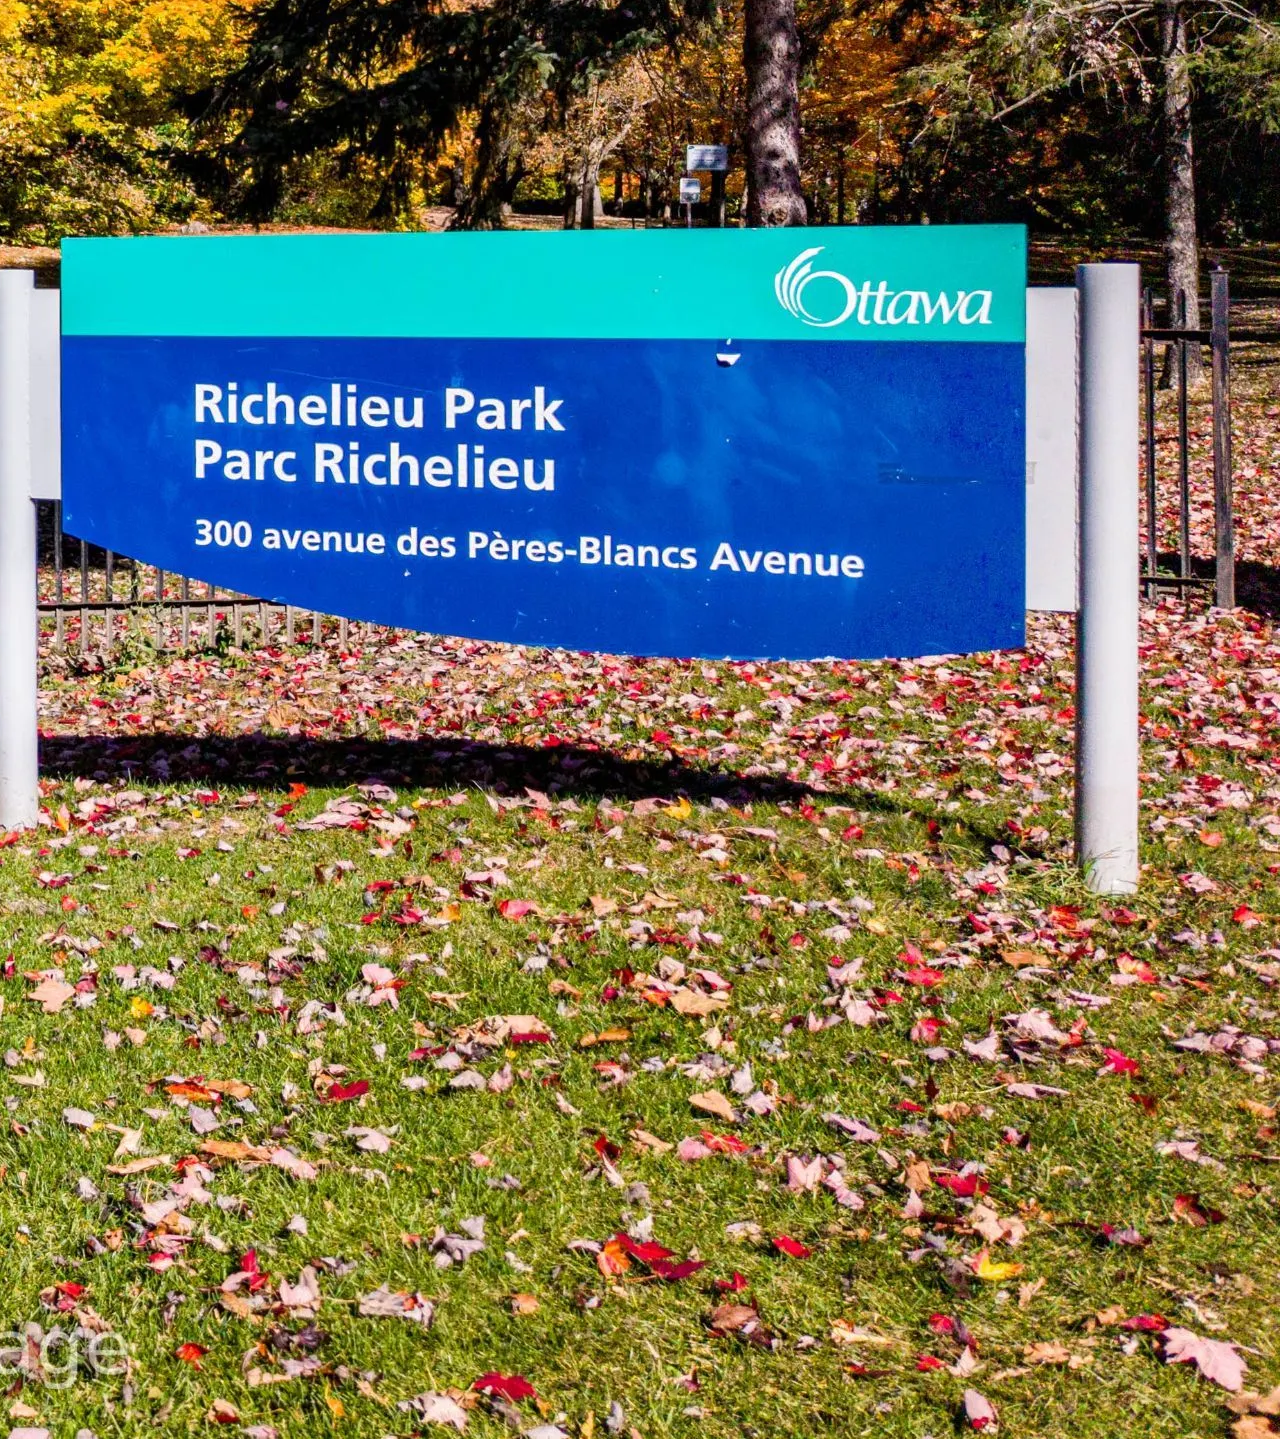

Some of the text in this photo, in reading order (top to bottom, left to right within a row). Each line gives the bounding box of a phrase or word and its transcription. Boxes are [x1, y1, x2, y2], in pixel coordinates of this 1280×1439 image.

[782, 260, 993, 328] Ottawa
[195, 382, 566, 431] Richelieu Park
[195, 439, 555, 491] Parc Richelieu
[195, 520, 865, 579] 300 avenue des Pères-Blancs Avenue
